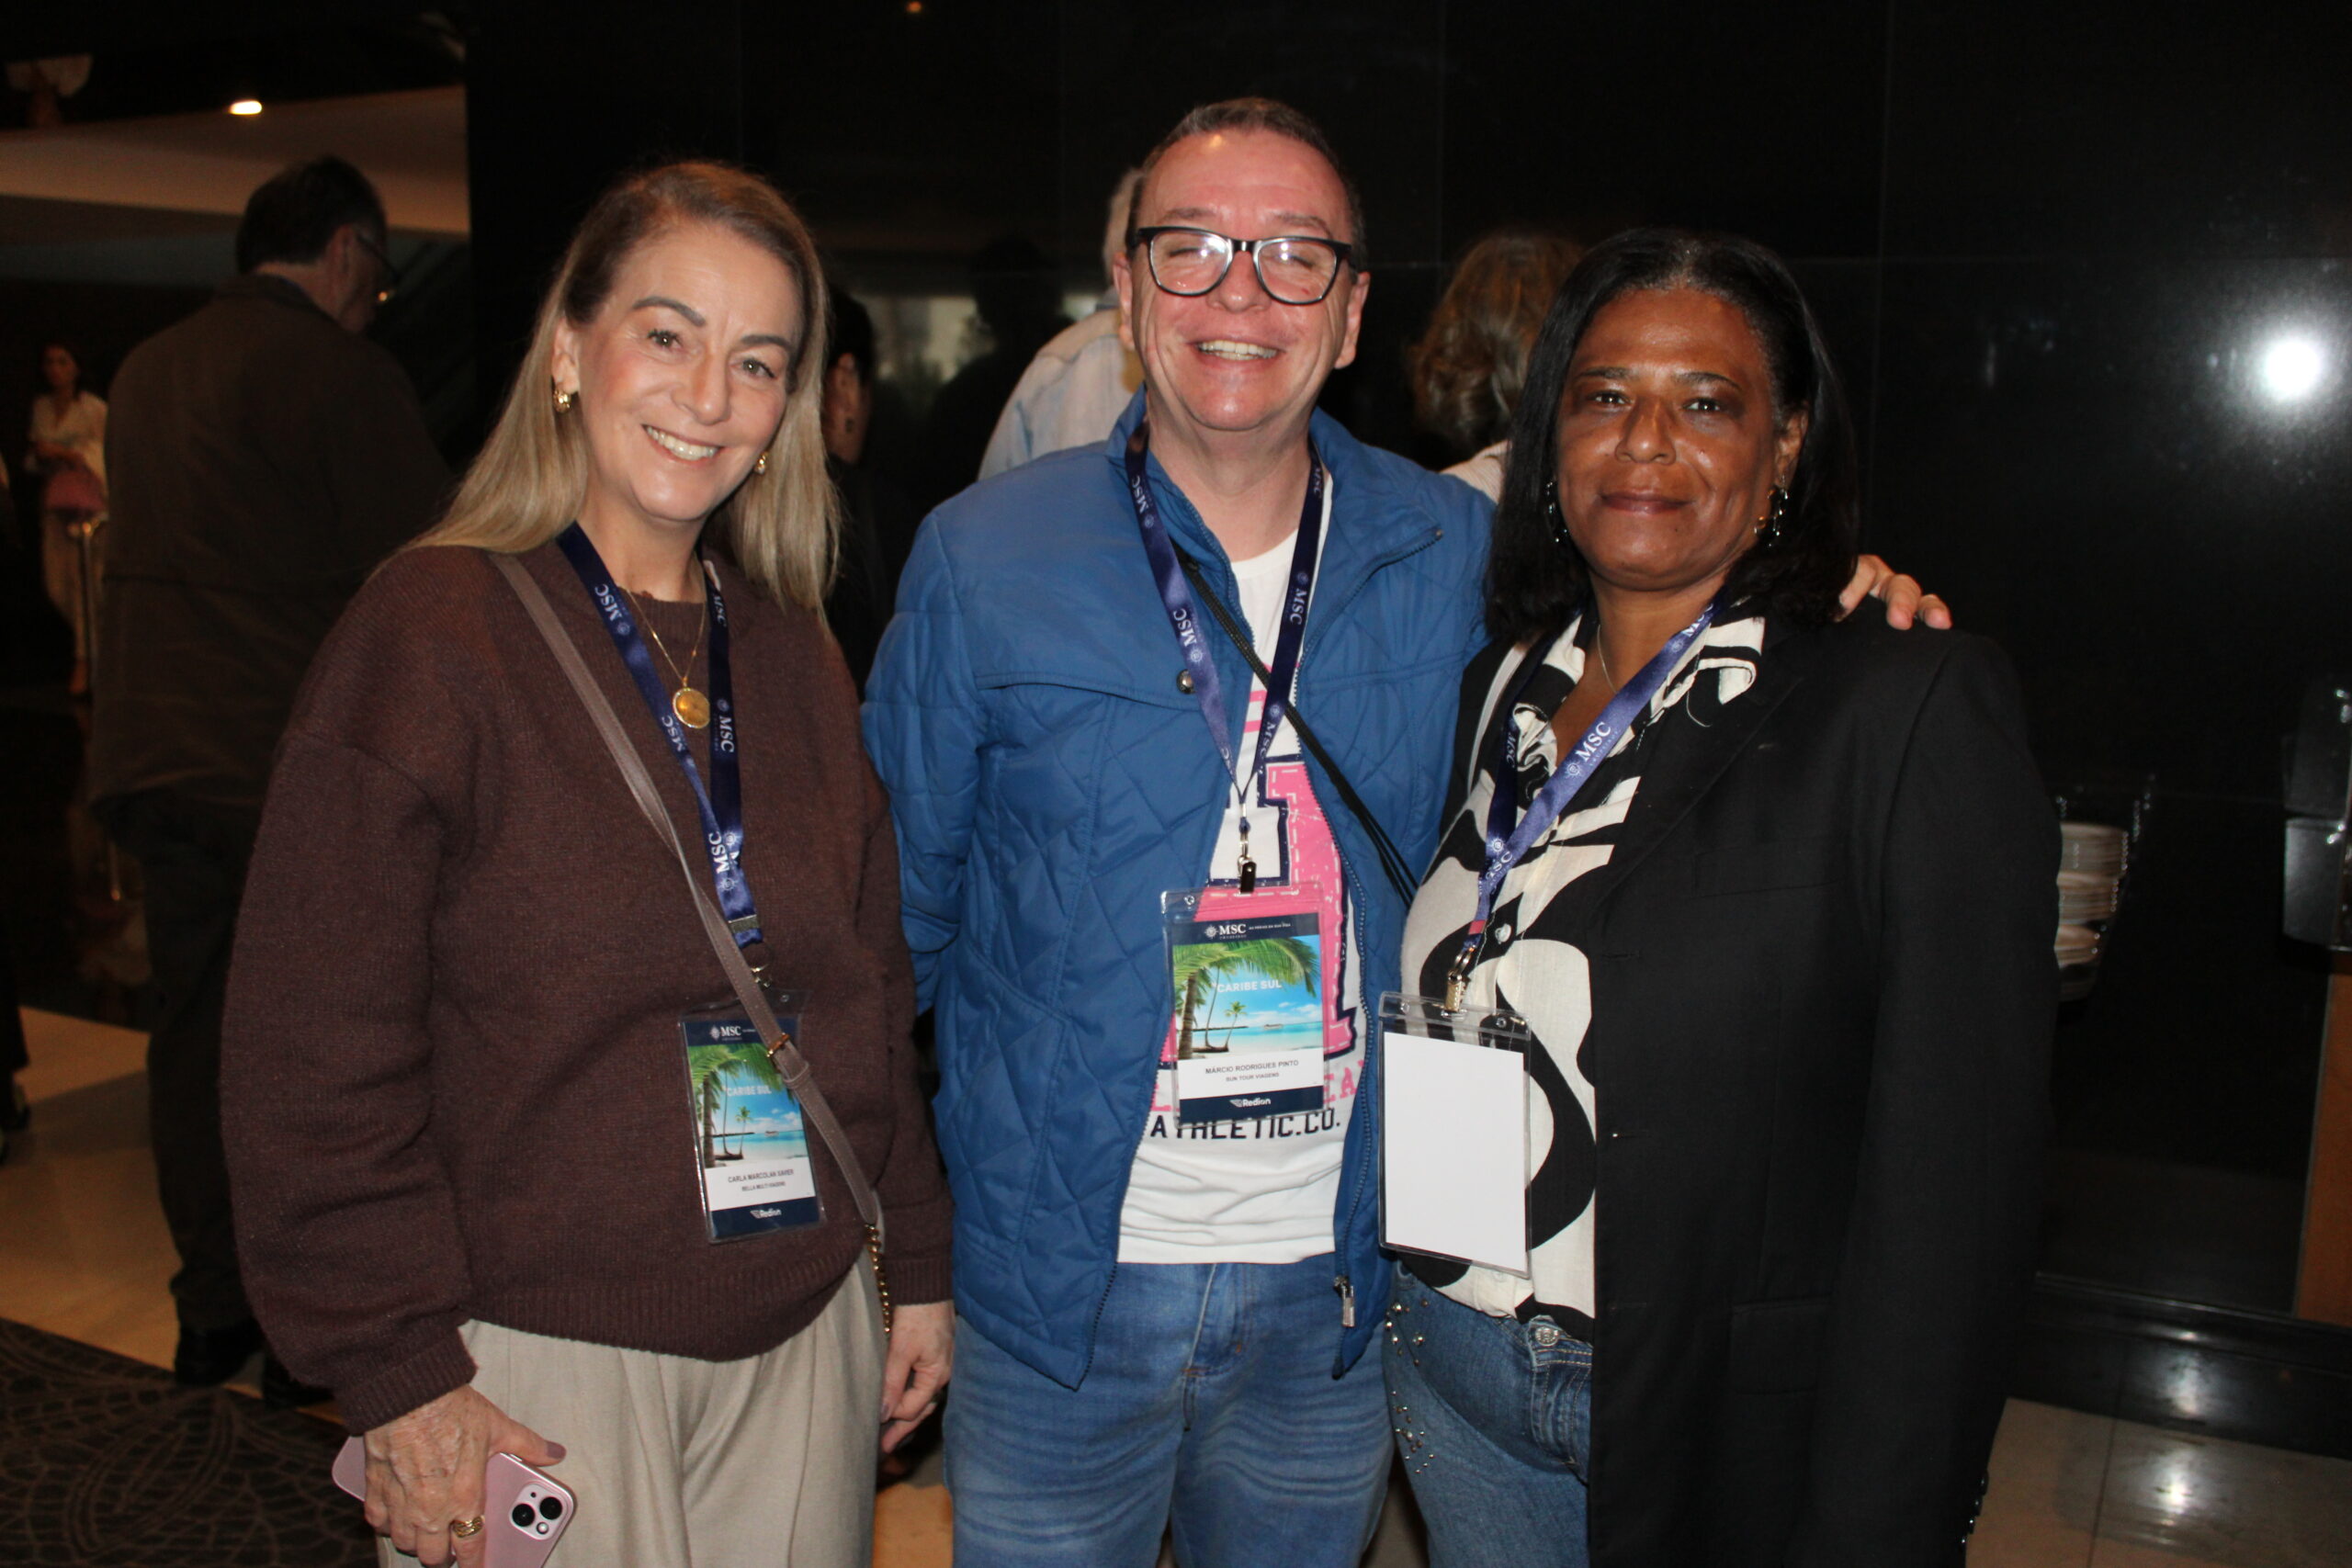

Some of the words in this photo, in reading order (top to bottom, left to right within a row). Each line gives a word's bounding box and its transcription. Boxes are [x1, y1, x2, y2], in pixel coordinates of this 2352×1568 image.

[1131, 475, 1149, 514] MSC
[594, 583, 622, 622] MSC
[712, 592, 727, 628] MSC
[1290, 587, 1307, 626] MSC
[1173, 608, 1197, 648] MSC
[718, 716, 735, 753] MSC
[1260, 722, 1276, 759] MSC
[1575, 721, 1611, 762] MSC
[708, 830, 730, 874] MSC
[1219, 924, 1247, 935] MSC
[1217, 980, 1258, 992] CARIBE
[1261, 979, 1283, 989] SUL
[720, 1025, 741, 1037] MSC
[1236, 1062, 1276, 1071] RODRIGUES
[1278, 1059, 1299, 1068] PINTO
